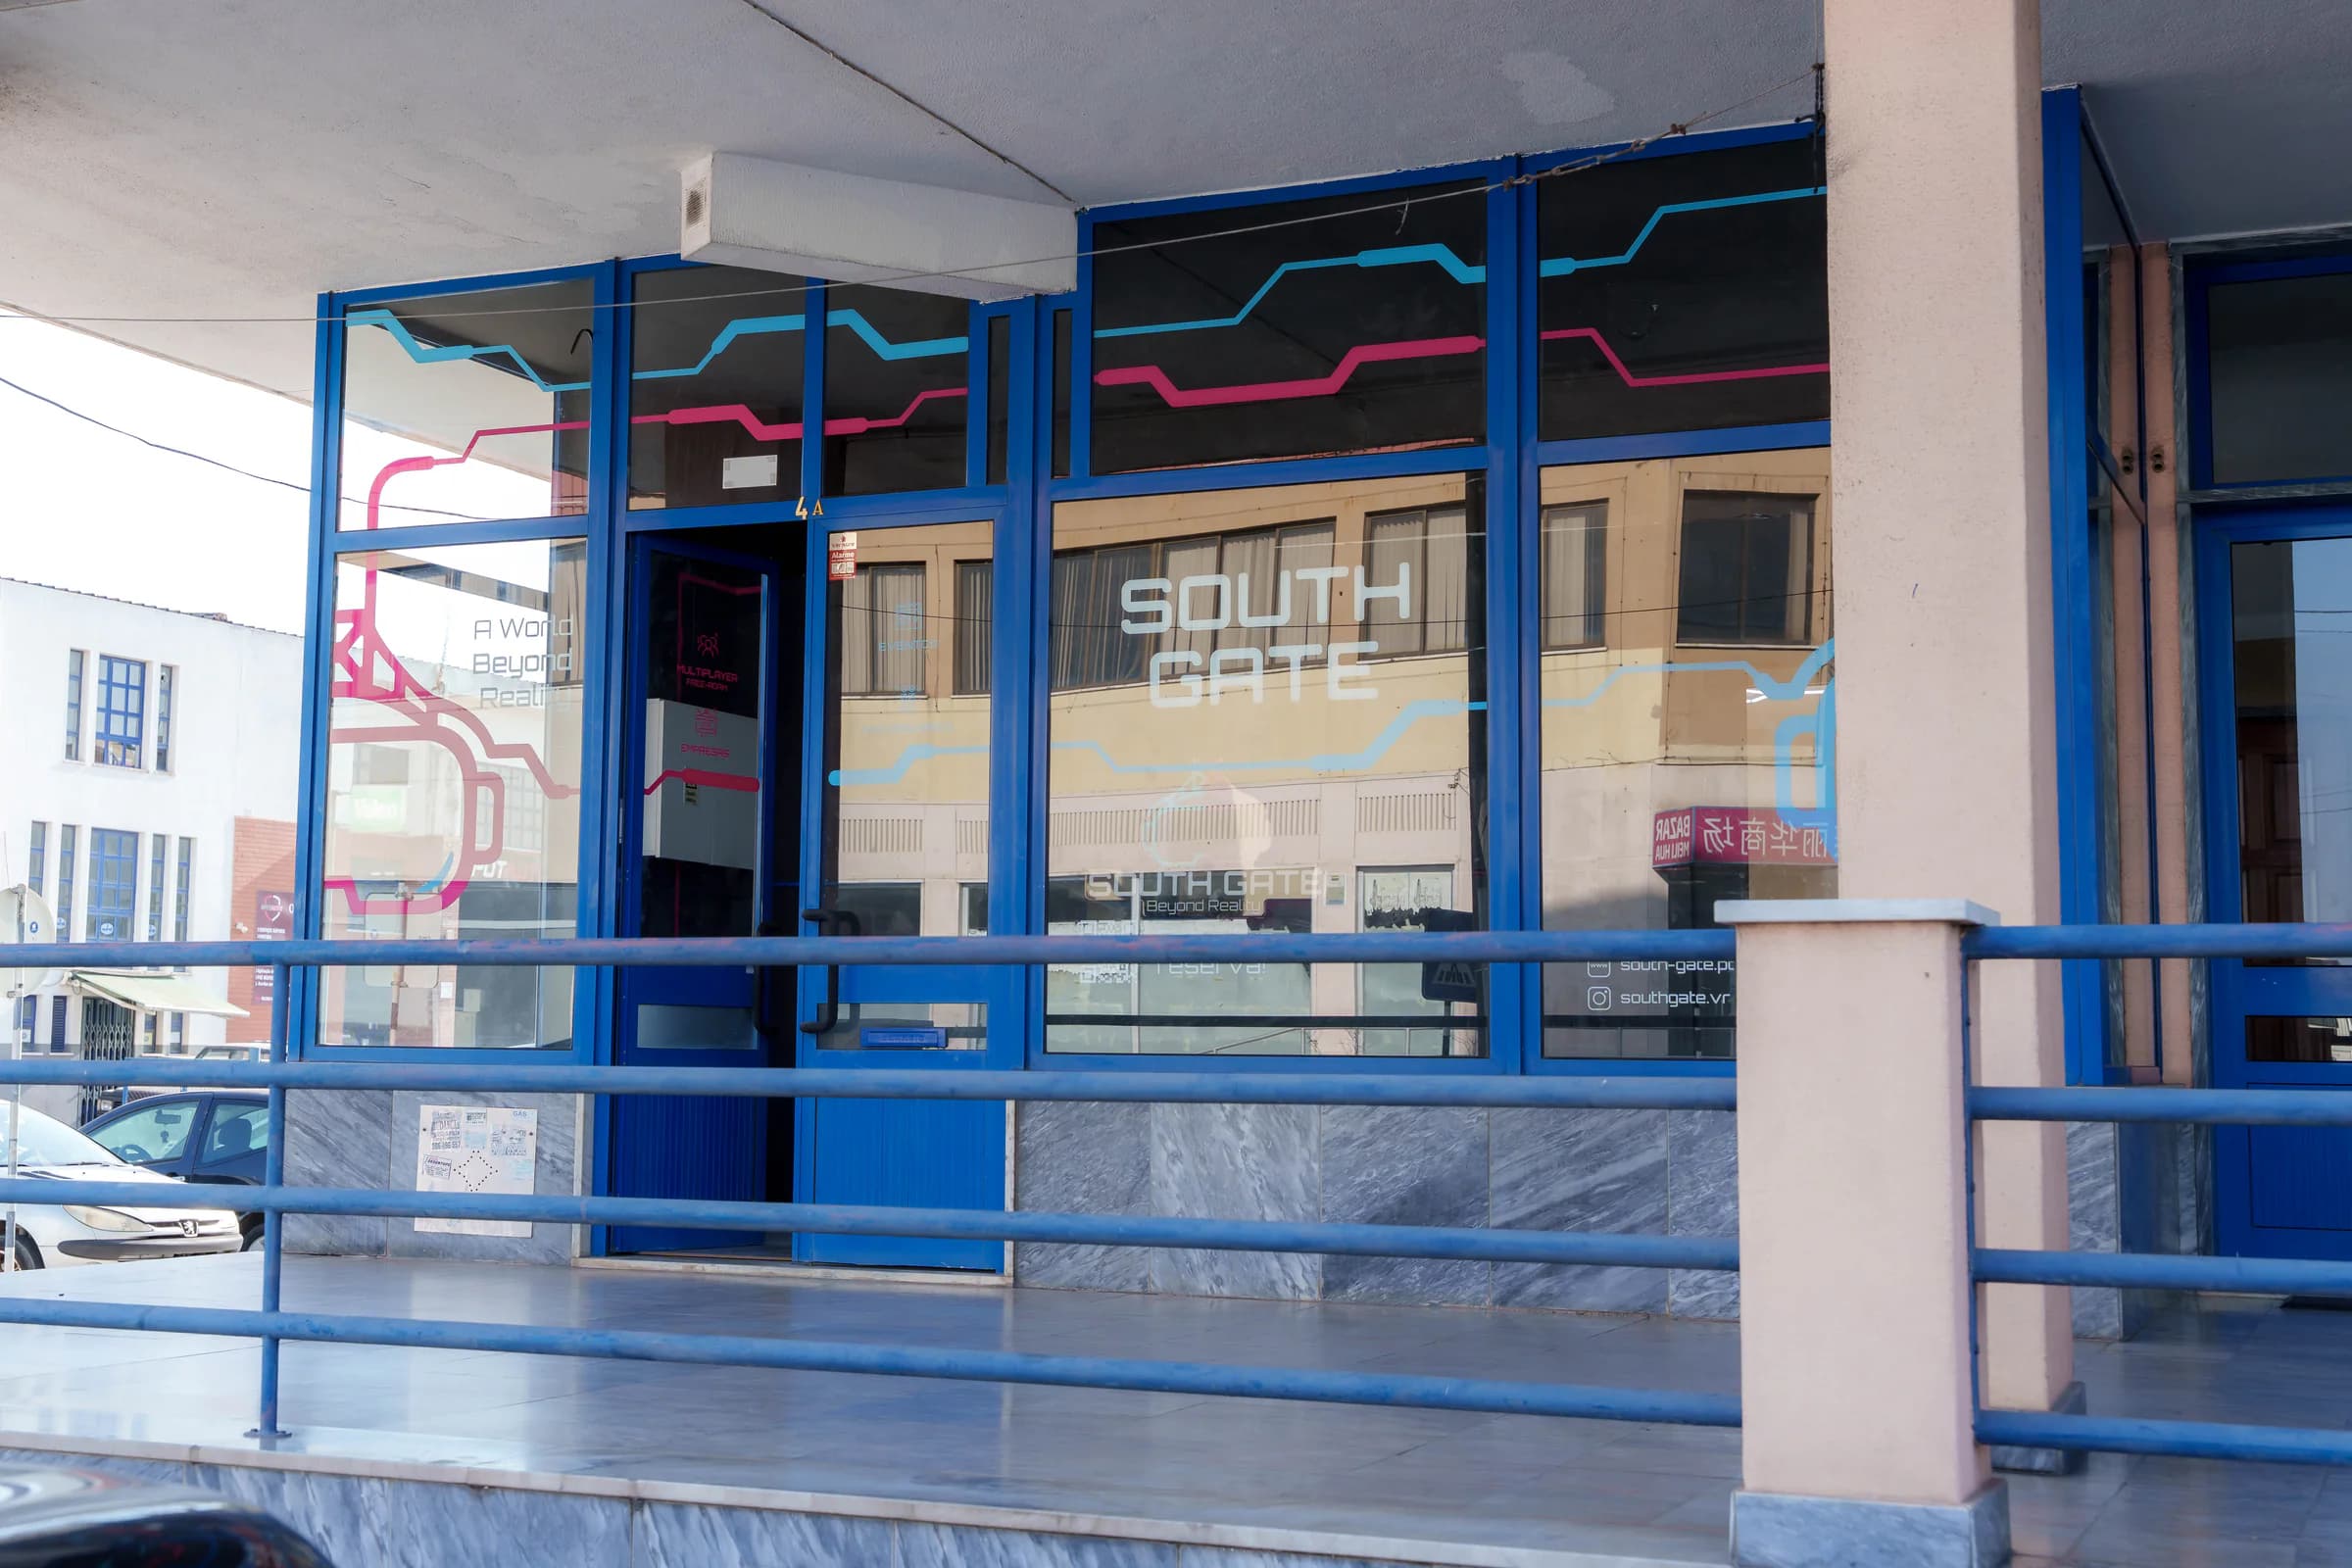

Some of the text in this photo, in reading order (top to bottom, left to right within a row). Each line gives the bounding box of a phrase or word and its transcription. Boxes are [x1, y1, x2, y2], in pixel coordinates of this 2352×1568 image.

[796, 496, 824, 520] 4 A
[1121, 562, 1410, 634] SOUTH
[473, 613, 573, 640] A World
[472, 647, 573, 679] Beyond
[676, 663, 738, 683] MULTIPLAYER
[1150, 641, 1379, 709] GATE
[480, 683, 561, 710] Reali
[1087, 869, 1323, 898] SOUTH GATE
[1147, 899, 1204, 915] Beyond
[1620, 991, 1731, 1007] southgate.vr
